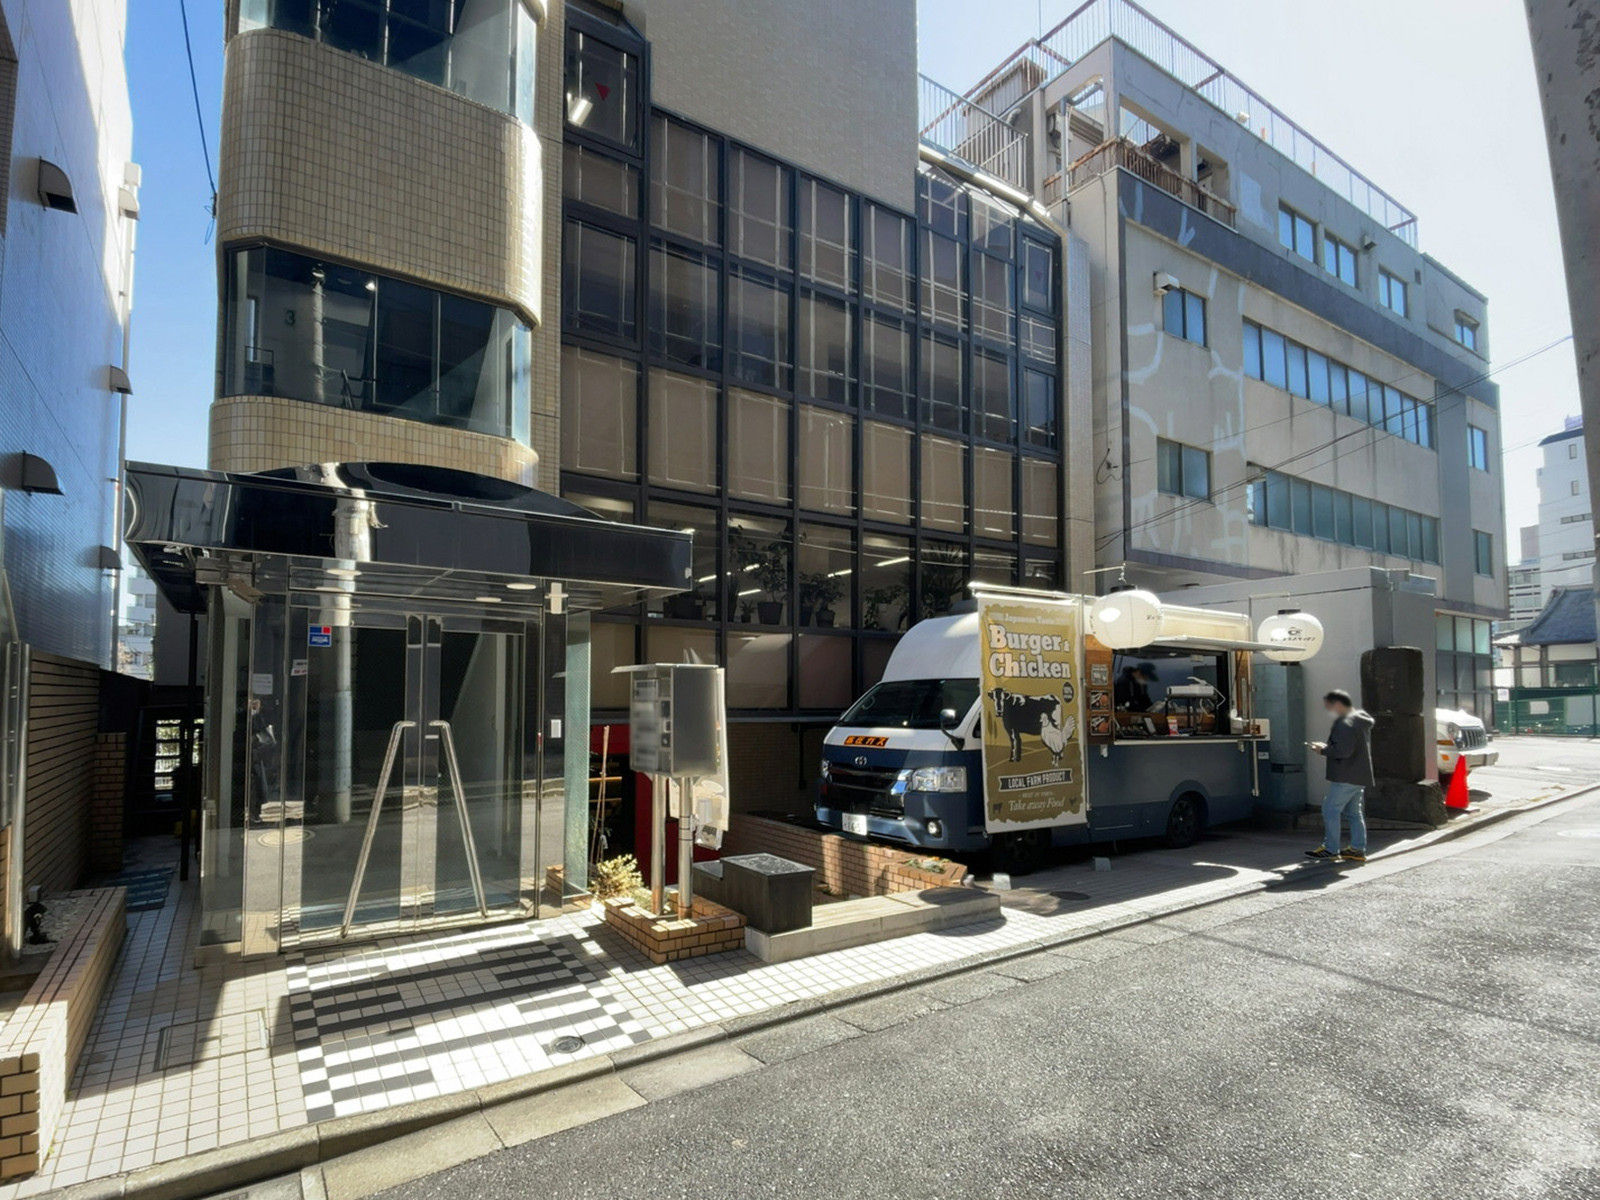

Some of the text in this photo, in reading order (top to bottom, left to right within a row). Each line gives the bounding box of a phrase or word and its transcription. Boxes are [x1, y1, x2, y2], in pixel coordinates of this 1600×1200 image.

[286, 308, 296, 327] 3
[989, 624, 1062, 655] Burger
[989, 652, 1071, 679] Chicken
[1008, 771, 1065, 789] LOCAL FARM PRODUCT
[1008, 799, 1026, 812] Take
[1026, 801, 1046, 812] away
[1046, 795, 1066, 808] Food
